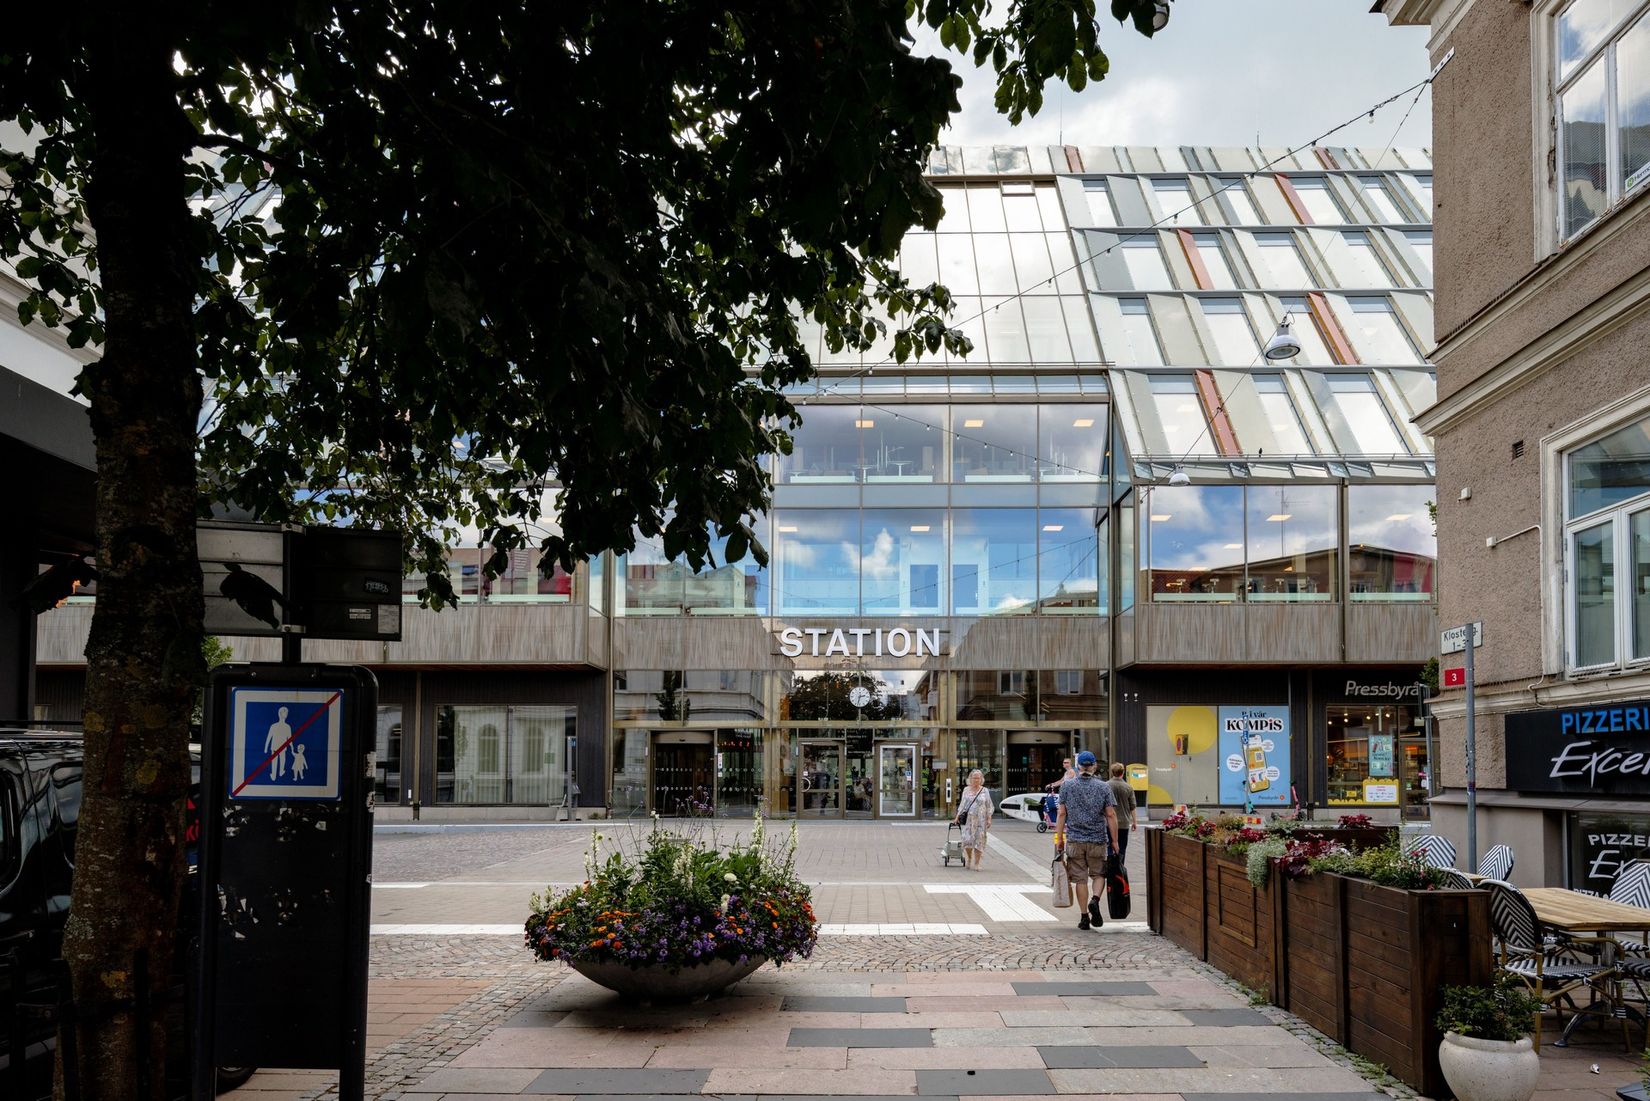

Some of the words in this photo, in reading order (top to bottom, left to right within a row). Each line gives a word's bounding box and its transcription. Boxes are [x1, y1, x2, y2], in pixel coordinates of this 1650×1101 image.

[780, 627, 940, 657] STATION
[1443, 626, 1479, 642] Klosteg-
[1451, 673, 1457, 682] 3
[1561, 706, 1650, 735] PIZZERI
[1588, 833, 1650, 848] PIZZE
